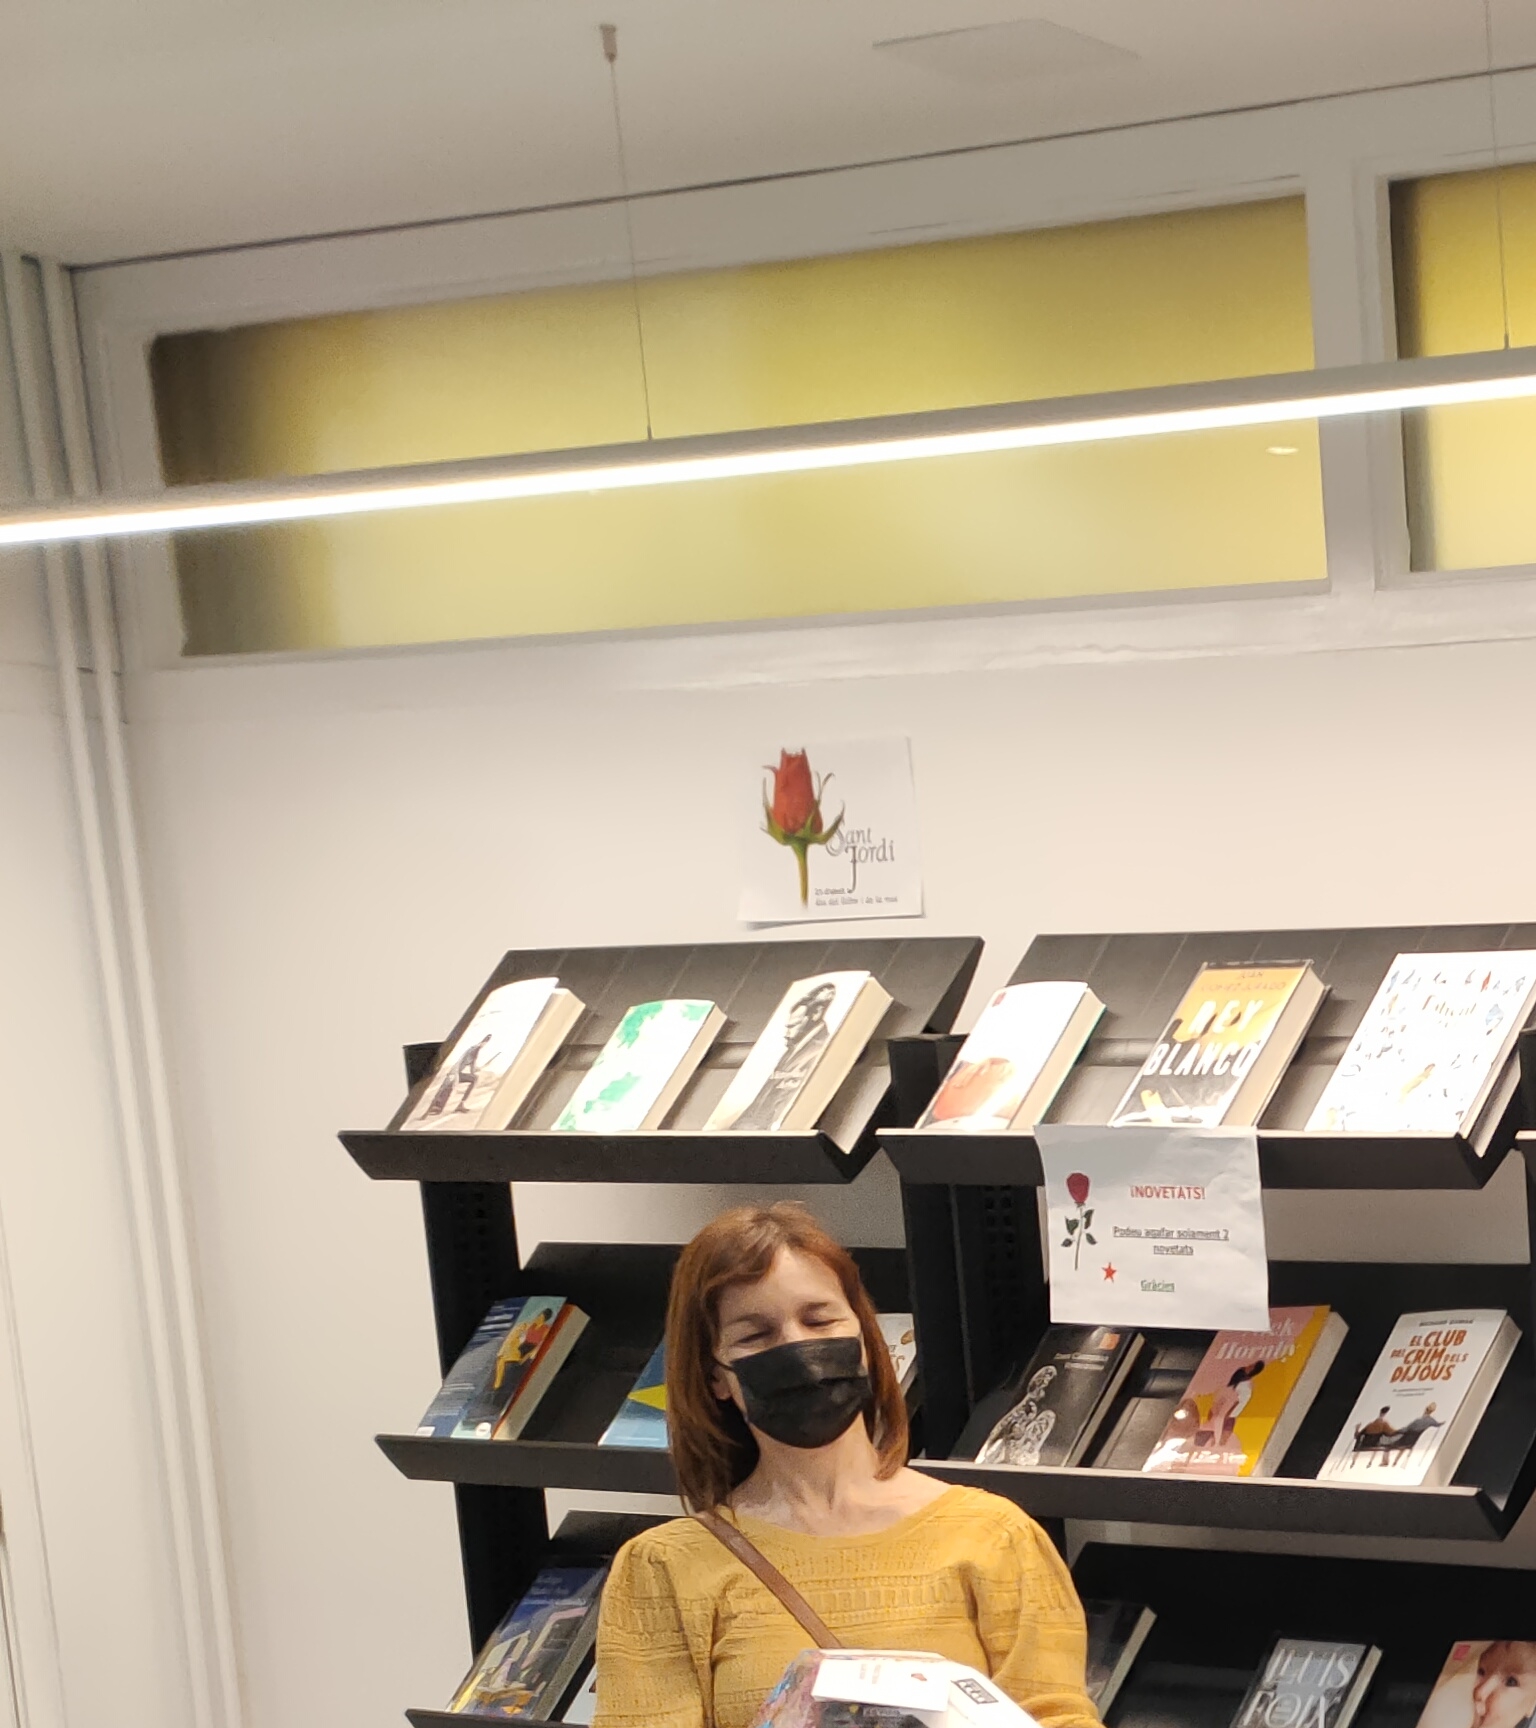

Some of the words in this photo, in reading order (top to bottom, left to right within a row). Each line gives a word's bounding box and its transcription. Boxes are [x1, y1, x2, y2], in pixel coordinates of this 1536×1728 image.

[1187, 1000, 1264, 1036] REY
[1143, 1042, 1260, 1076] BLANCO
[1113, 1226, 1142, 1237] Podeu
[1145, 1228, 1174, 1240] agafar
[1222, 1230, 1229, 1239] 2
[1422, 1329, 1468, 1348] CLUB
[1403, 1347, 1446, 1365] CRIM
[1390, 1363, 1456, 1384] DIJOUS
